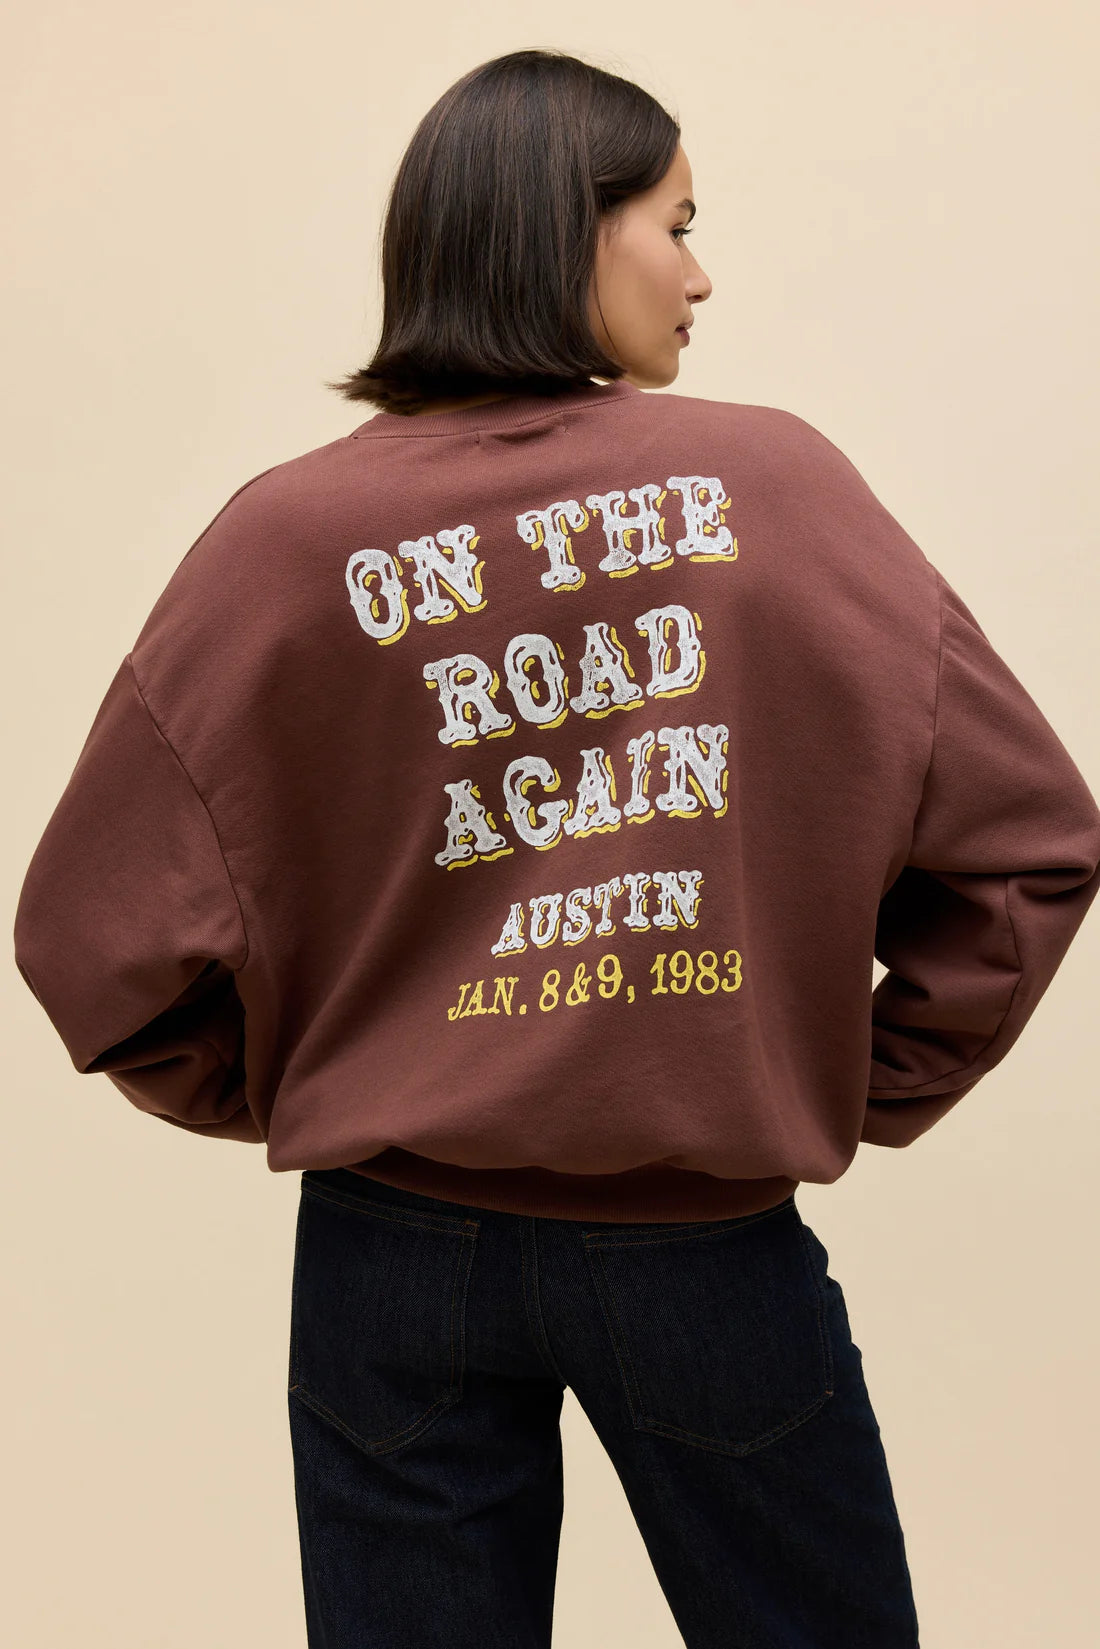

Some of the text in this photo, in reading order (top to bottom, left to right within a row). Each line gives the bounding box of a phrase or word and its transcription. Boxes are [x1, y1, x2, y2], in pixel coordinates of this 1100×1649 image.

[346, 475, 739, 645] ON THE
[423, 604, 706, 748] ROAD
[435, 724, 729, 871] AGAIN
[448, 977, 528, 1021] JAN.
[650, 950, 743, 995] 1983
[491, 870, 704, 959] AUSTIN
